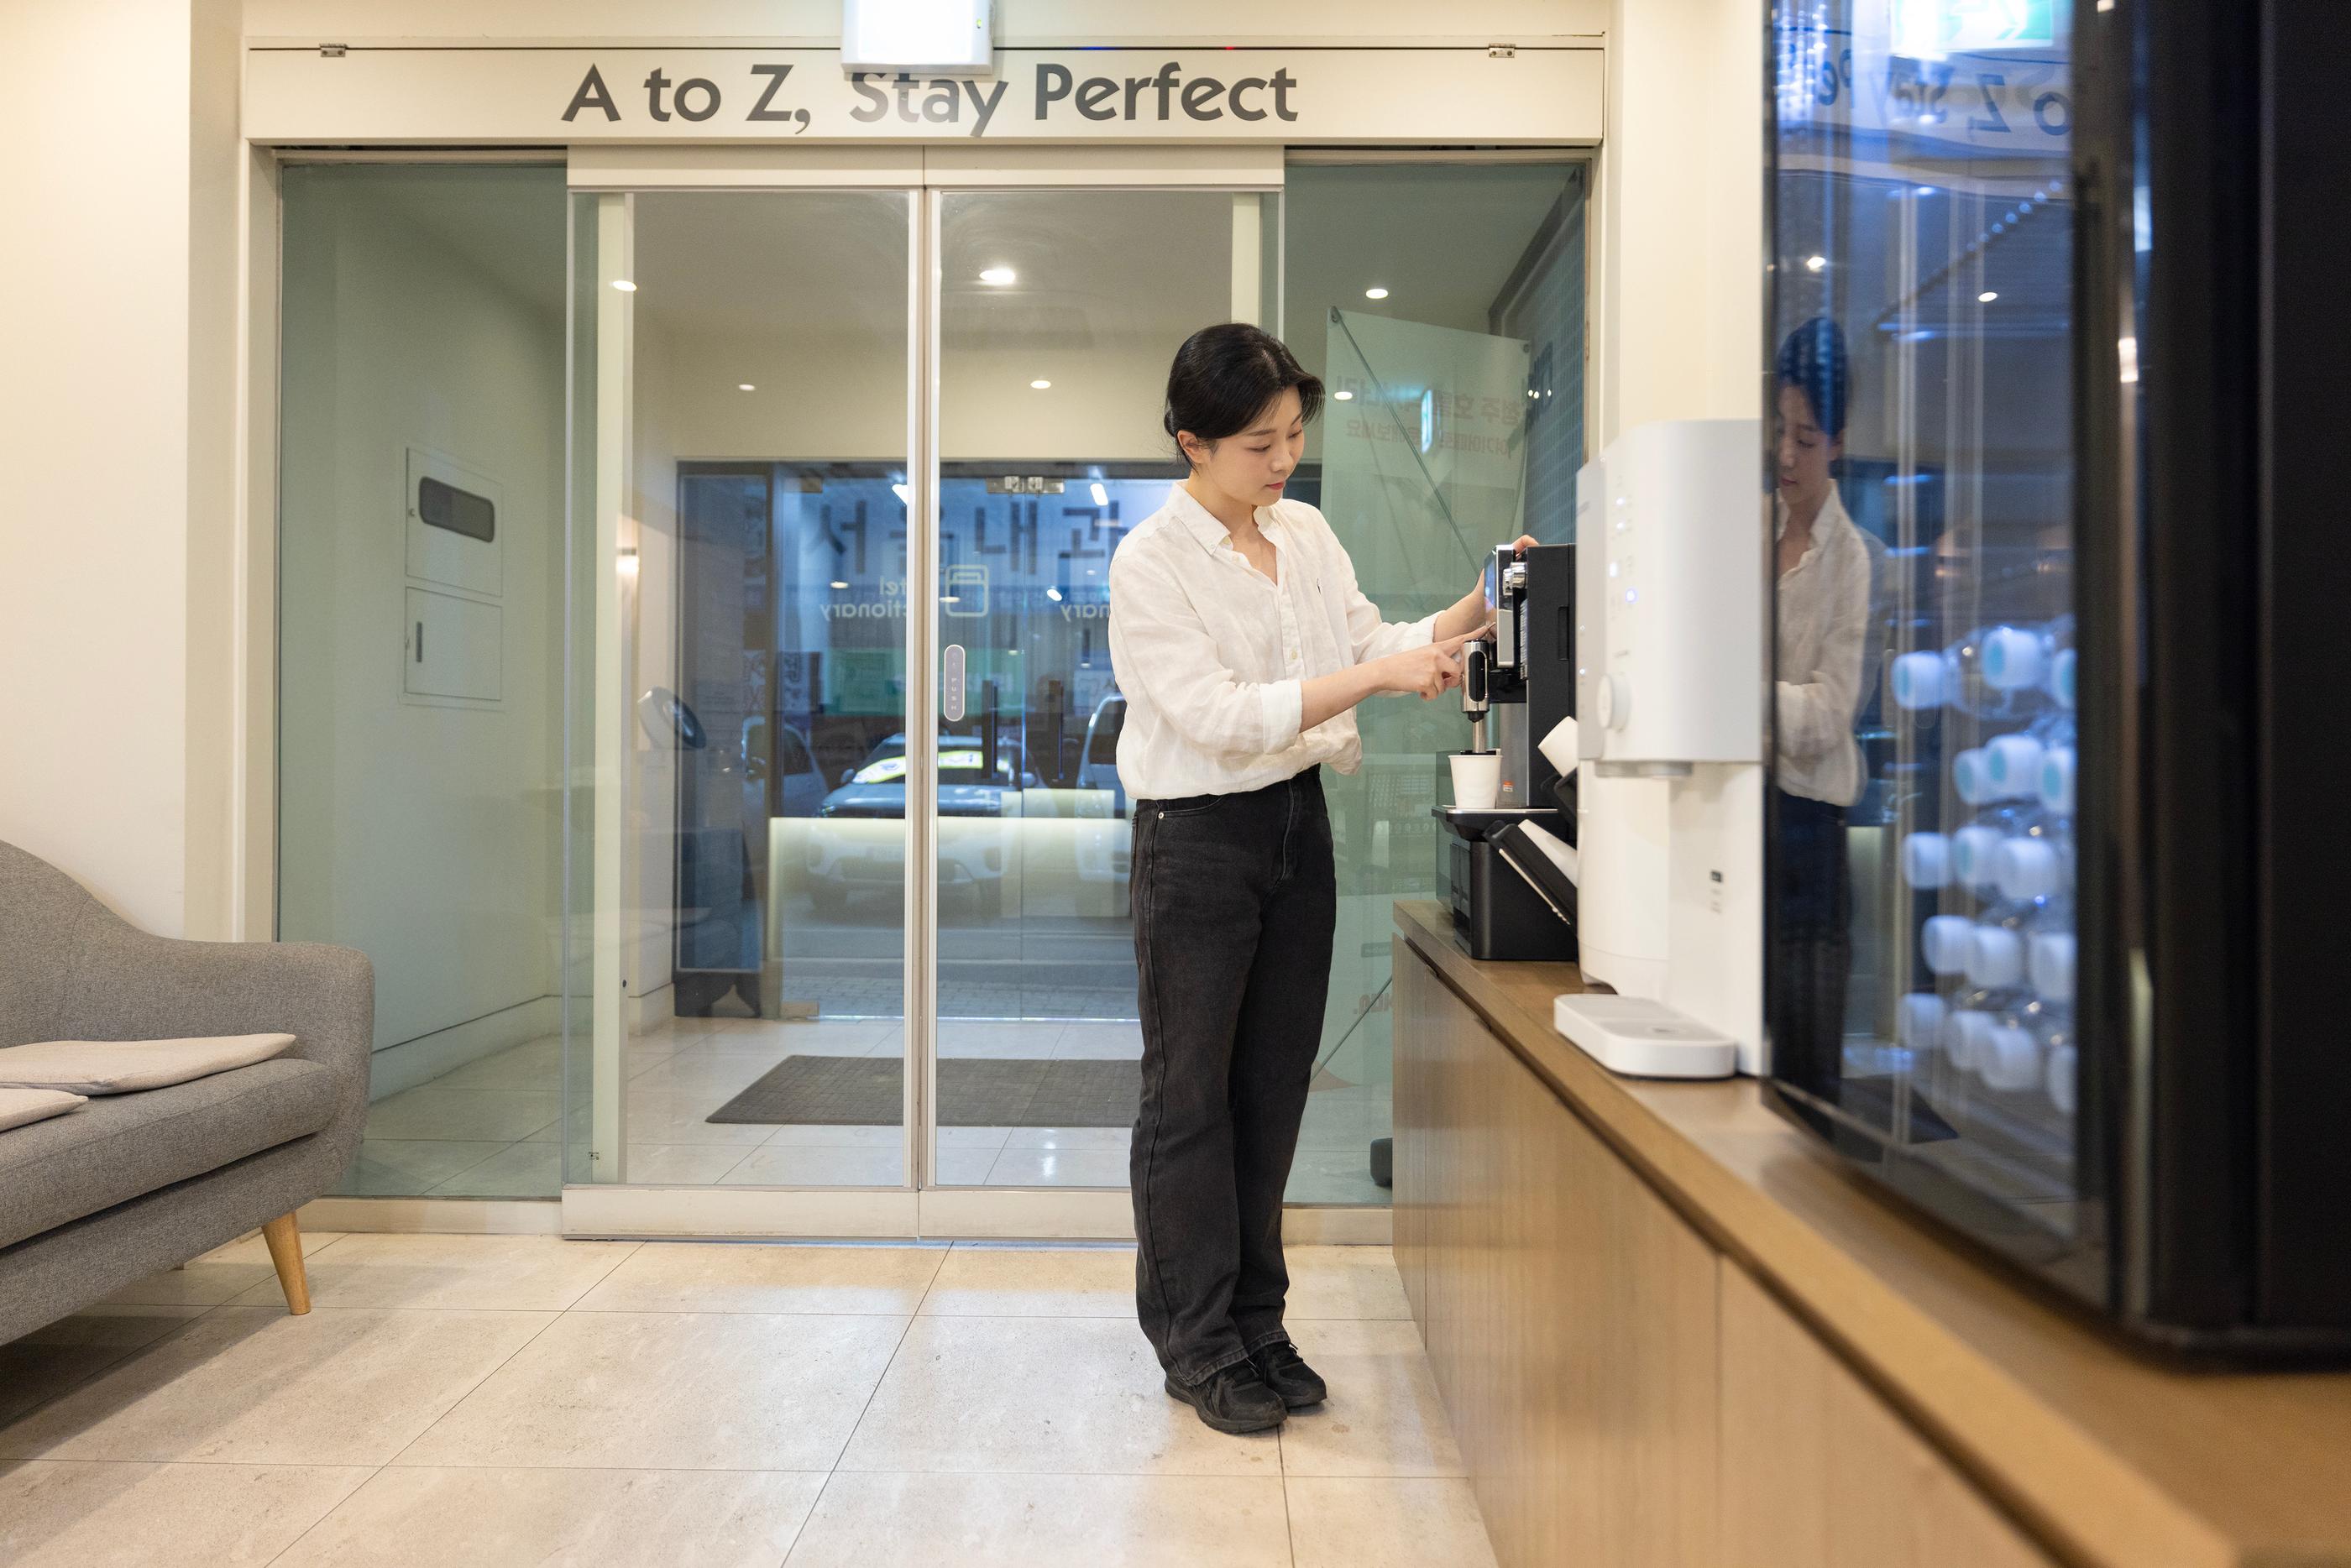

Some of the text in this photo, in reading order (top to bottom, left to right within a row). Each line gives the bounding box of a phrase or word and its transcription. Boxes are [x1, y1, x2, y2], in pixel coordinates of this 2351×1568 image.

[560, 62, 1299, 138] A to Z, Stay Perfect
